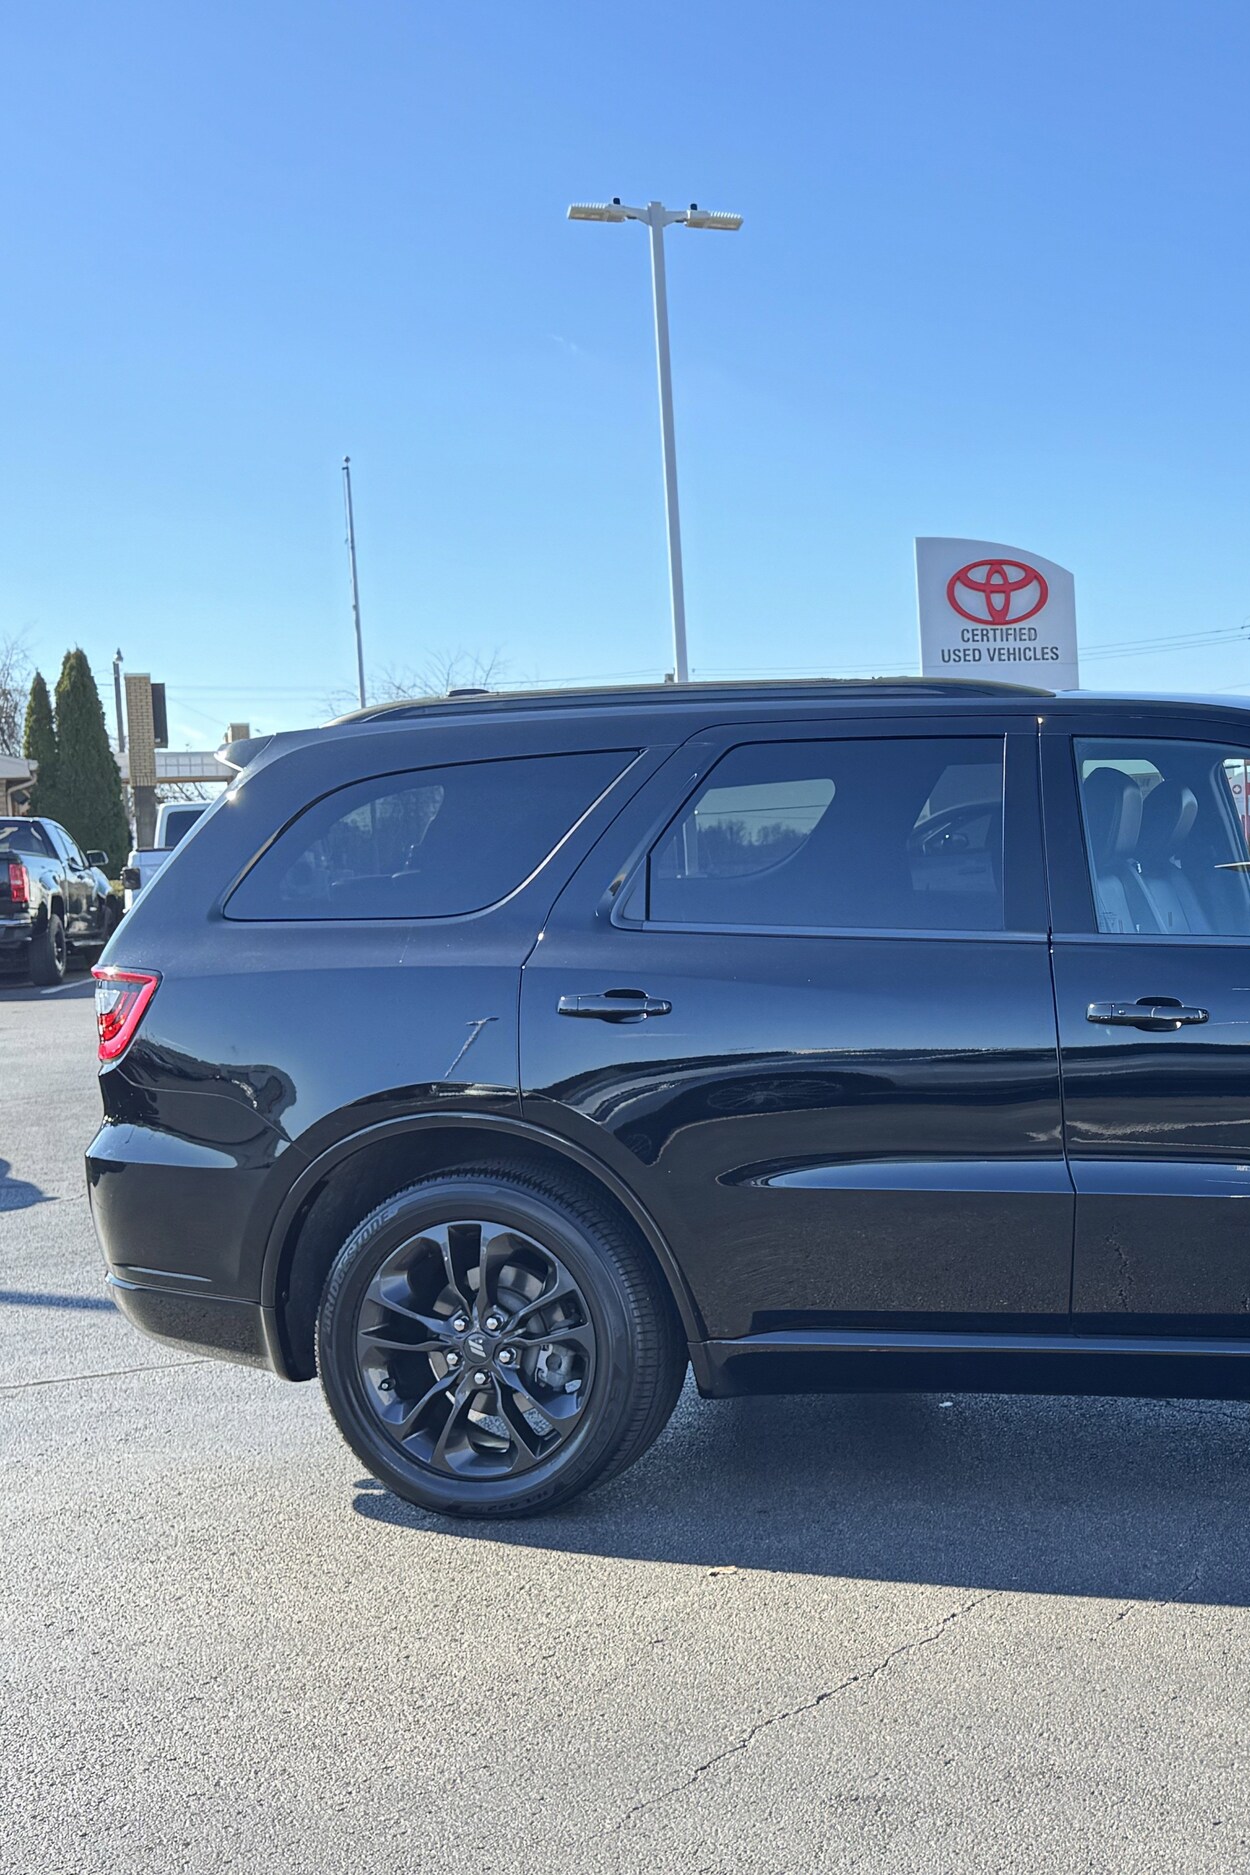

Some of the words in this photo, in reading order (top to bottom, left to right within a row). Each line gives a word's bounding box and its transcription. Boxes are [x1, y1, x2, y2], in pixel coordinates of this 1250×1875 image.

[961, 627, 1038, 643] CERTIFIED
[941, 648, 982, 663] USED
[987, 646, 1060, 662] VEHICLES
[322, 1209, 390, 1335] BRIDGESTONE
